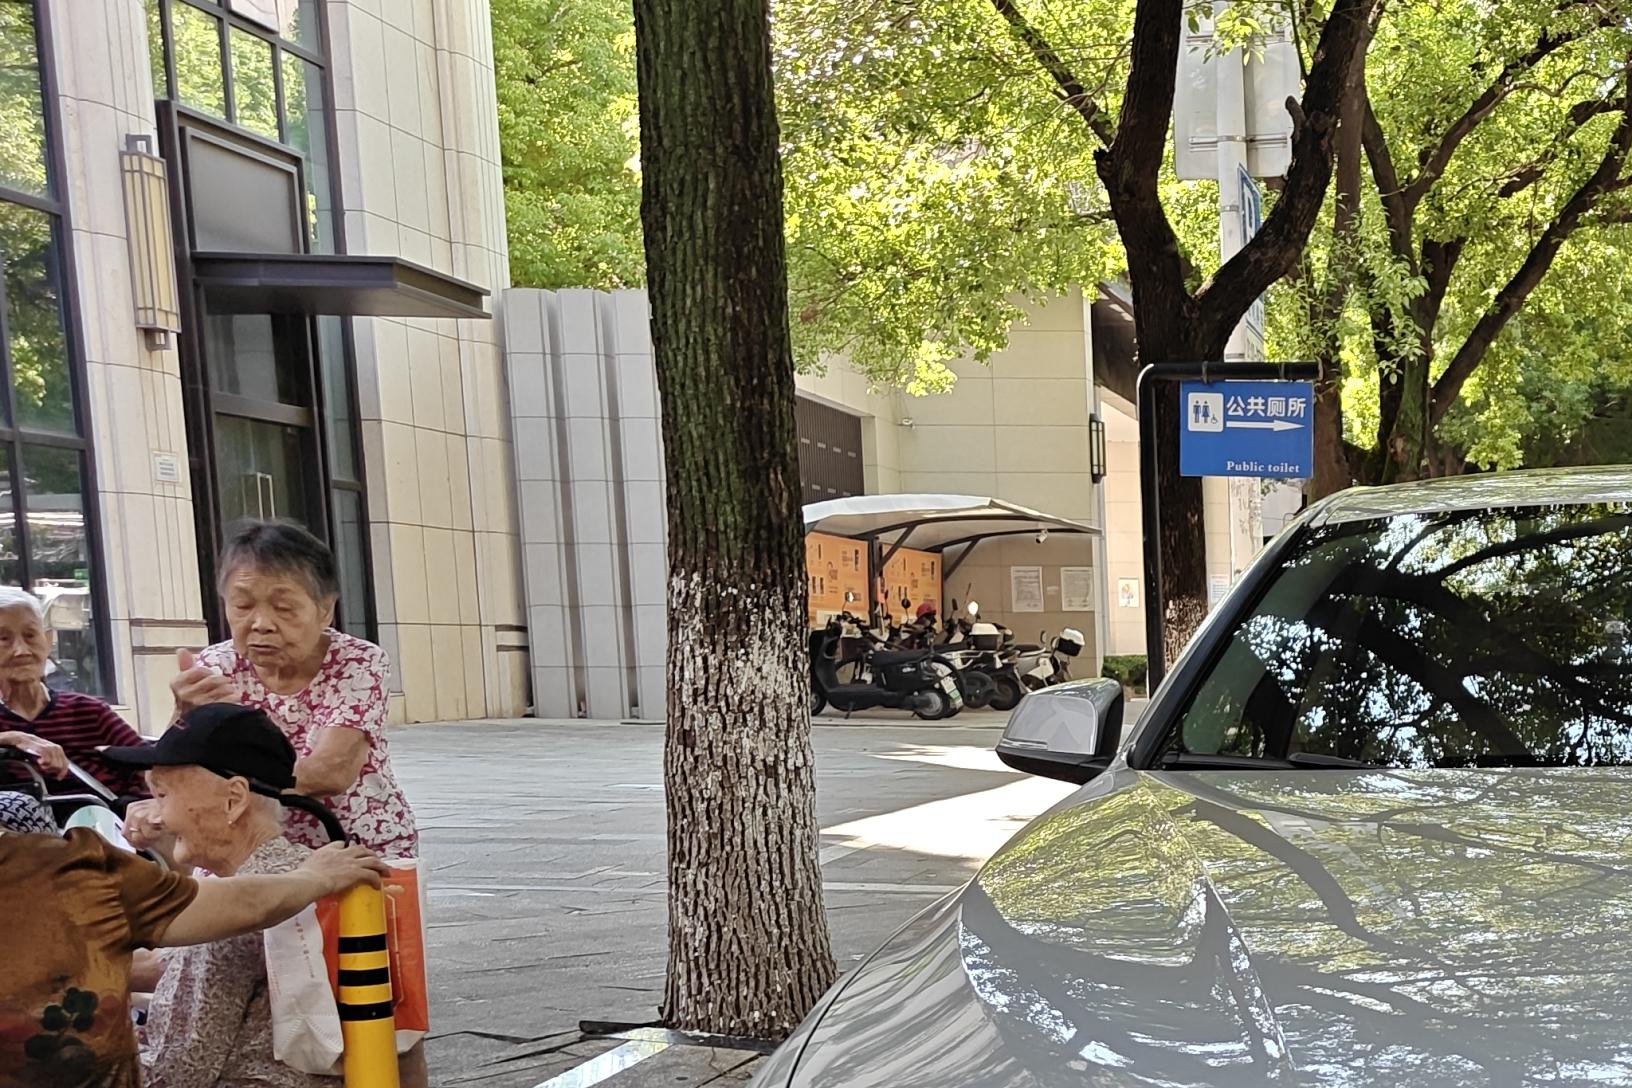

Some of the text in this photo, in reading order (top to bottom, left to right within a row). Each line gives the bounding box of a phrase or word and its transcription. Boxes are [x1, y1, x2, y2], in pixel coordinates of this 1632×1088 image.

[1226, 396, 1306, 418] 公共厕所
[1226, 460, 1300, 473] Public toilet
